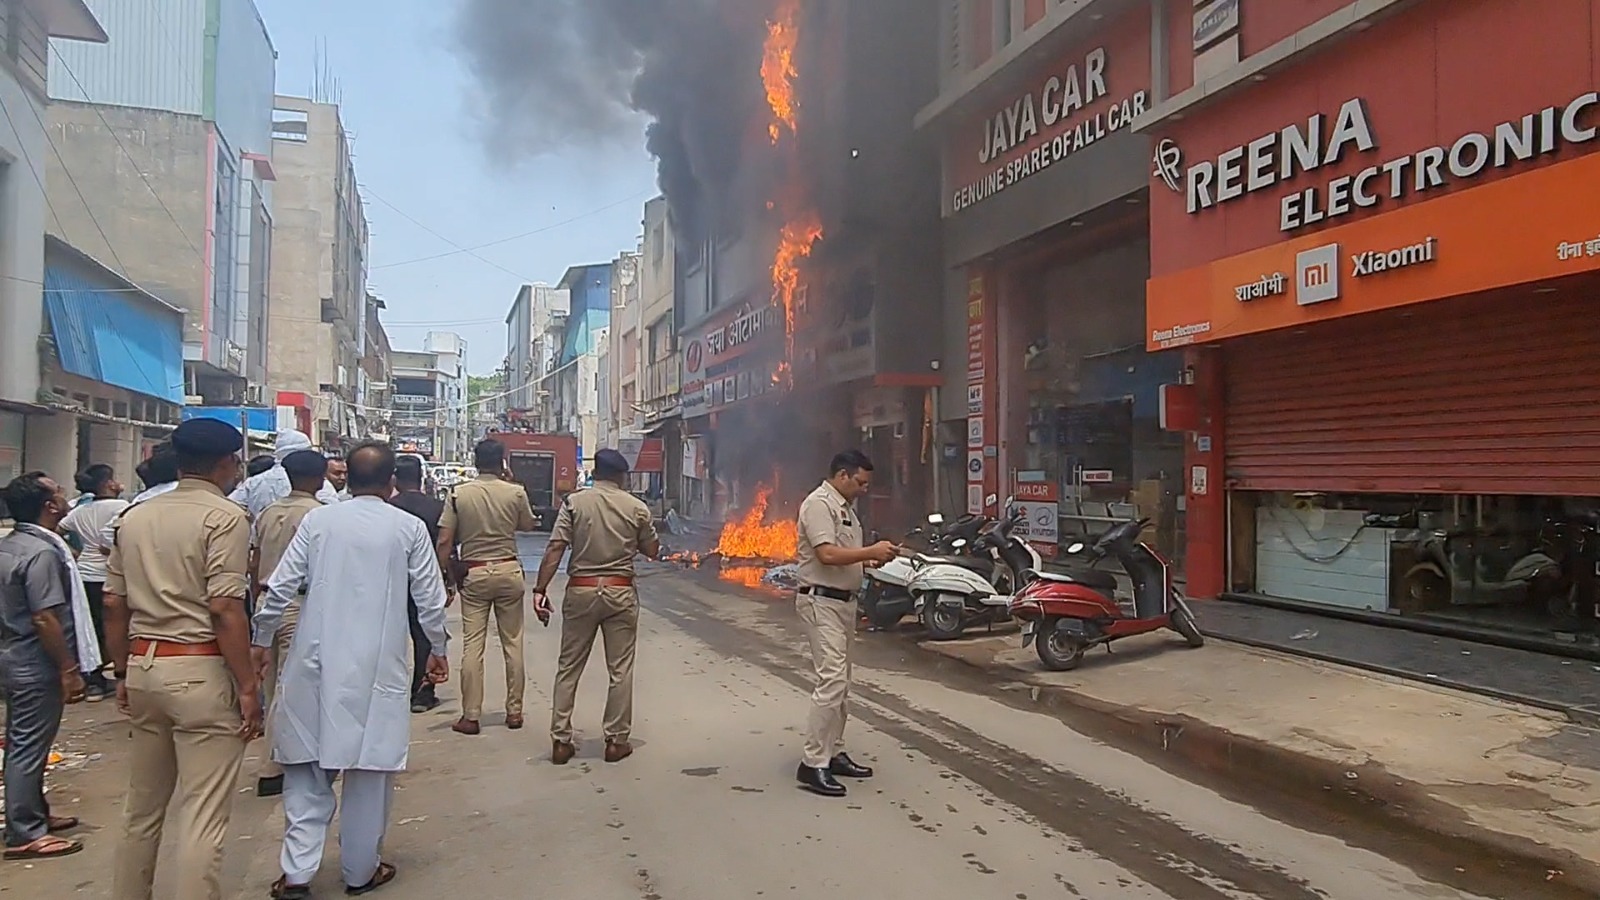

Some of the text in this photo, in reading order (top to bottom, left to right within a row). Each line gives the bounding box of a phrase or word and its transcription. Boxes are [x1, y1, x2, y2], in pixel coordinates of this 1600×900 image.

[979, 47, 1107, 164] JAYA CAR
[953, 90, 1146, 212] GENUINE SPARE OF ALL CAR
[1186, 97, 1374, 215] REENA
[1280, 92, 1598, 232] ELECTRONIC
[1350, 236, 1434, 278] Xiaomi
[1556, 241, 1583, 261] रीना
[1234, 271, 1286, 302] शाओमी
[560, 466, 568, 476] 2
[1033, 485, 1049, 496] CAR
